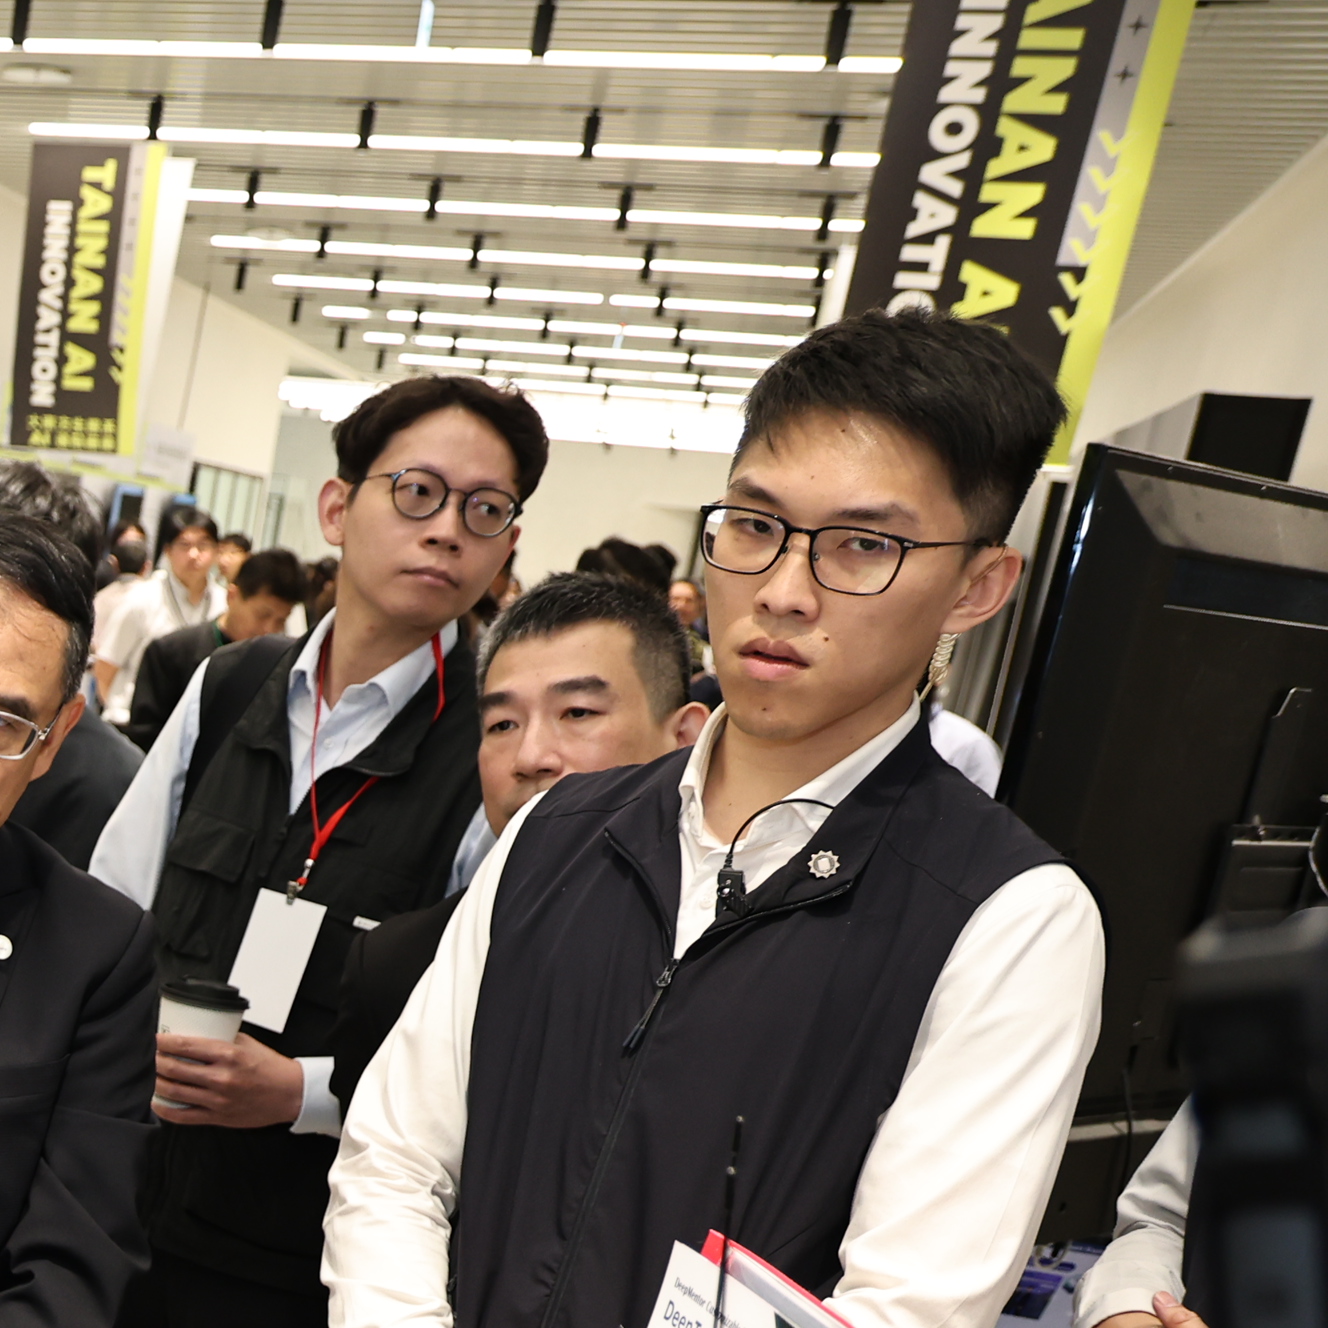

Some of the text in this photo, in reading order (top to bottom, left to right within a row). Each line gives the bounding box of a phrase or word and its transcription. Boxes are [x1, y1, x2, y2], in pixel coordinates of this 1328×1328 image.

[29, 199, 74, 408] INNOVATION
[65, 157, 118, 334] TAINAN
[60, 340, 97, 392] AI
